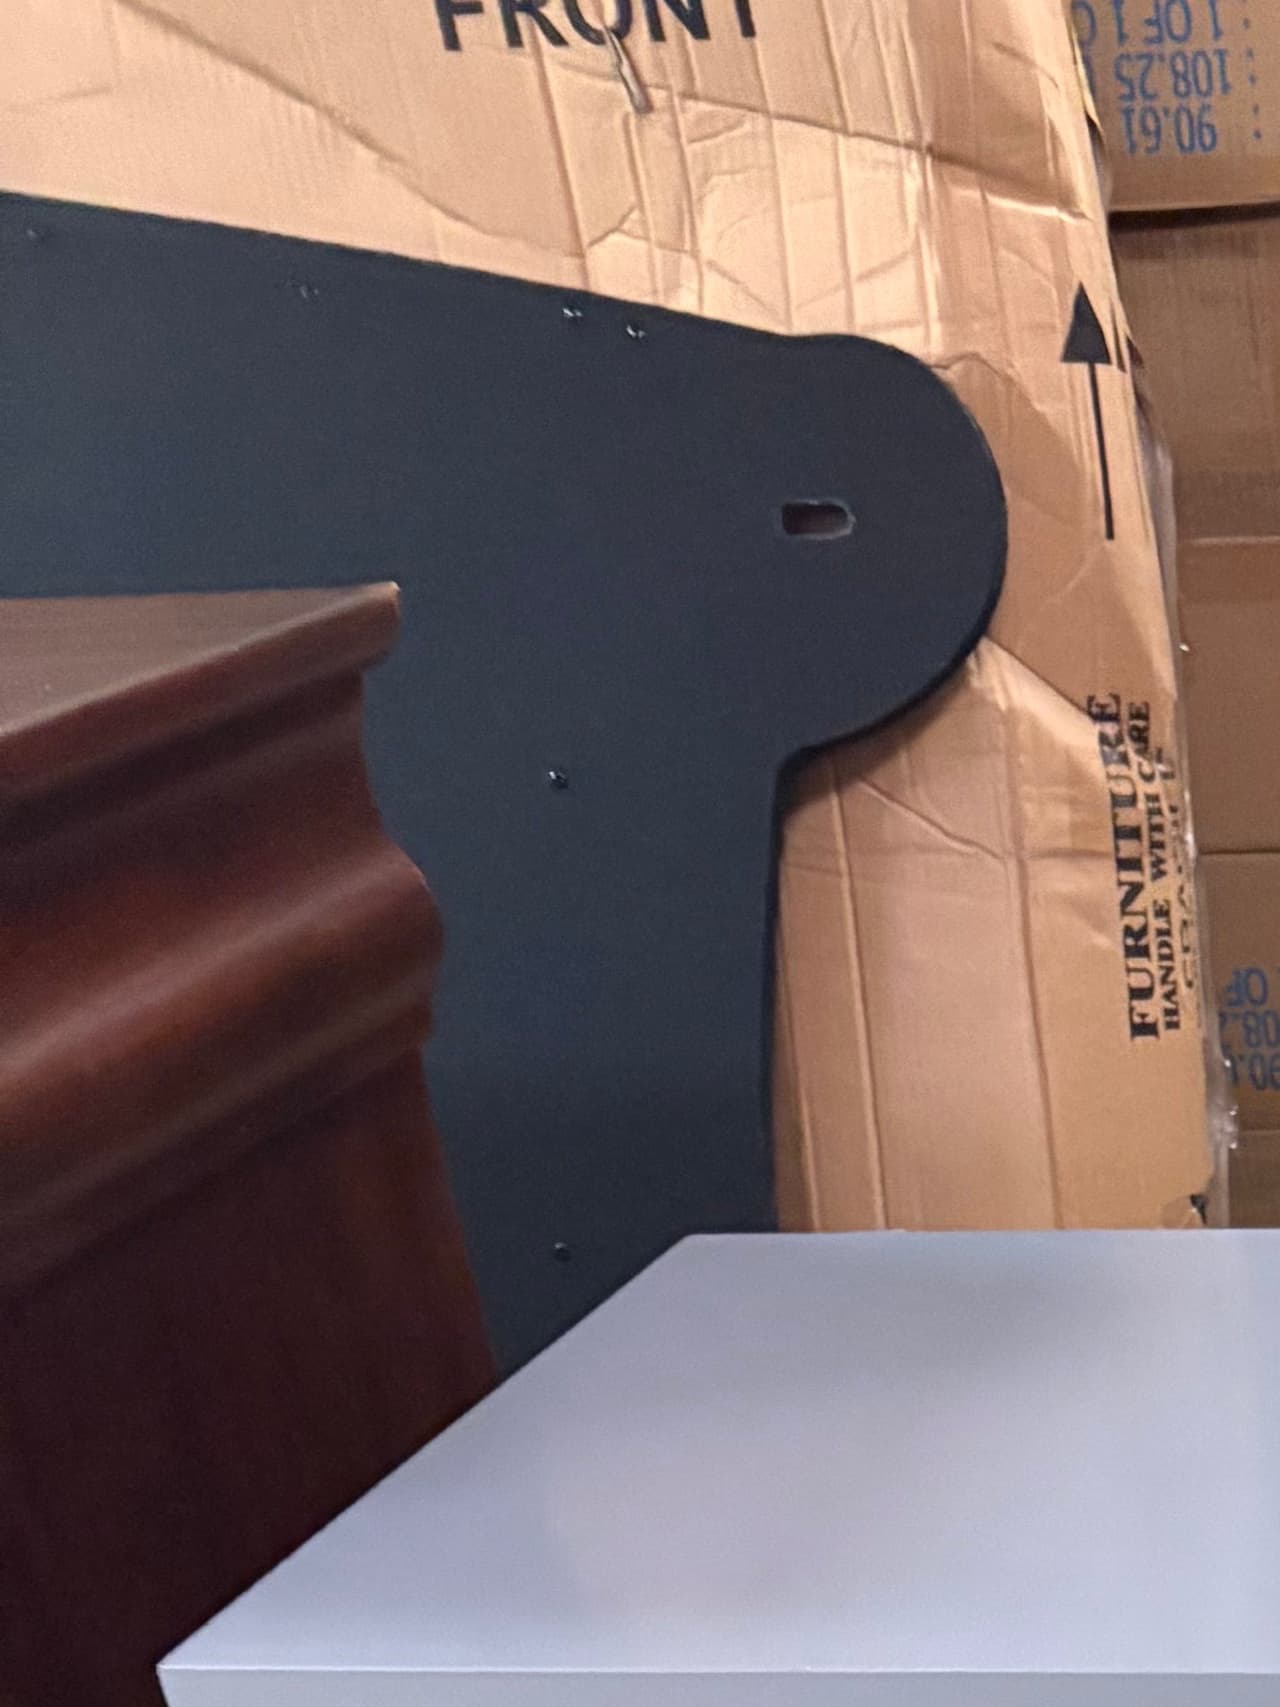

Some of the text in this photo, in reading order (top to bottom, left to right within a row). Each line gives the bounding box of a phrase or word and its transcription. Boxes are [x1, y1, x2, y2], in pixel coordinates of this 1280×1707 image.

[1114, 48, 1232, 101] 108.25
[1121, 103, 1218, 154] 90.61
[1129, 701, 1156, 784] CARE
[1089, 692, 1160, 1041] FURNITURE
[1145, 792, 1168, 882] WITH
[1154, 899, 1181, 1031] HANDLE
